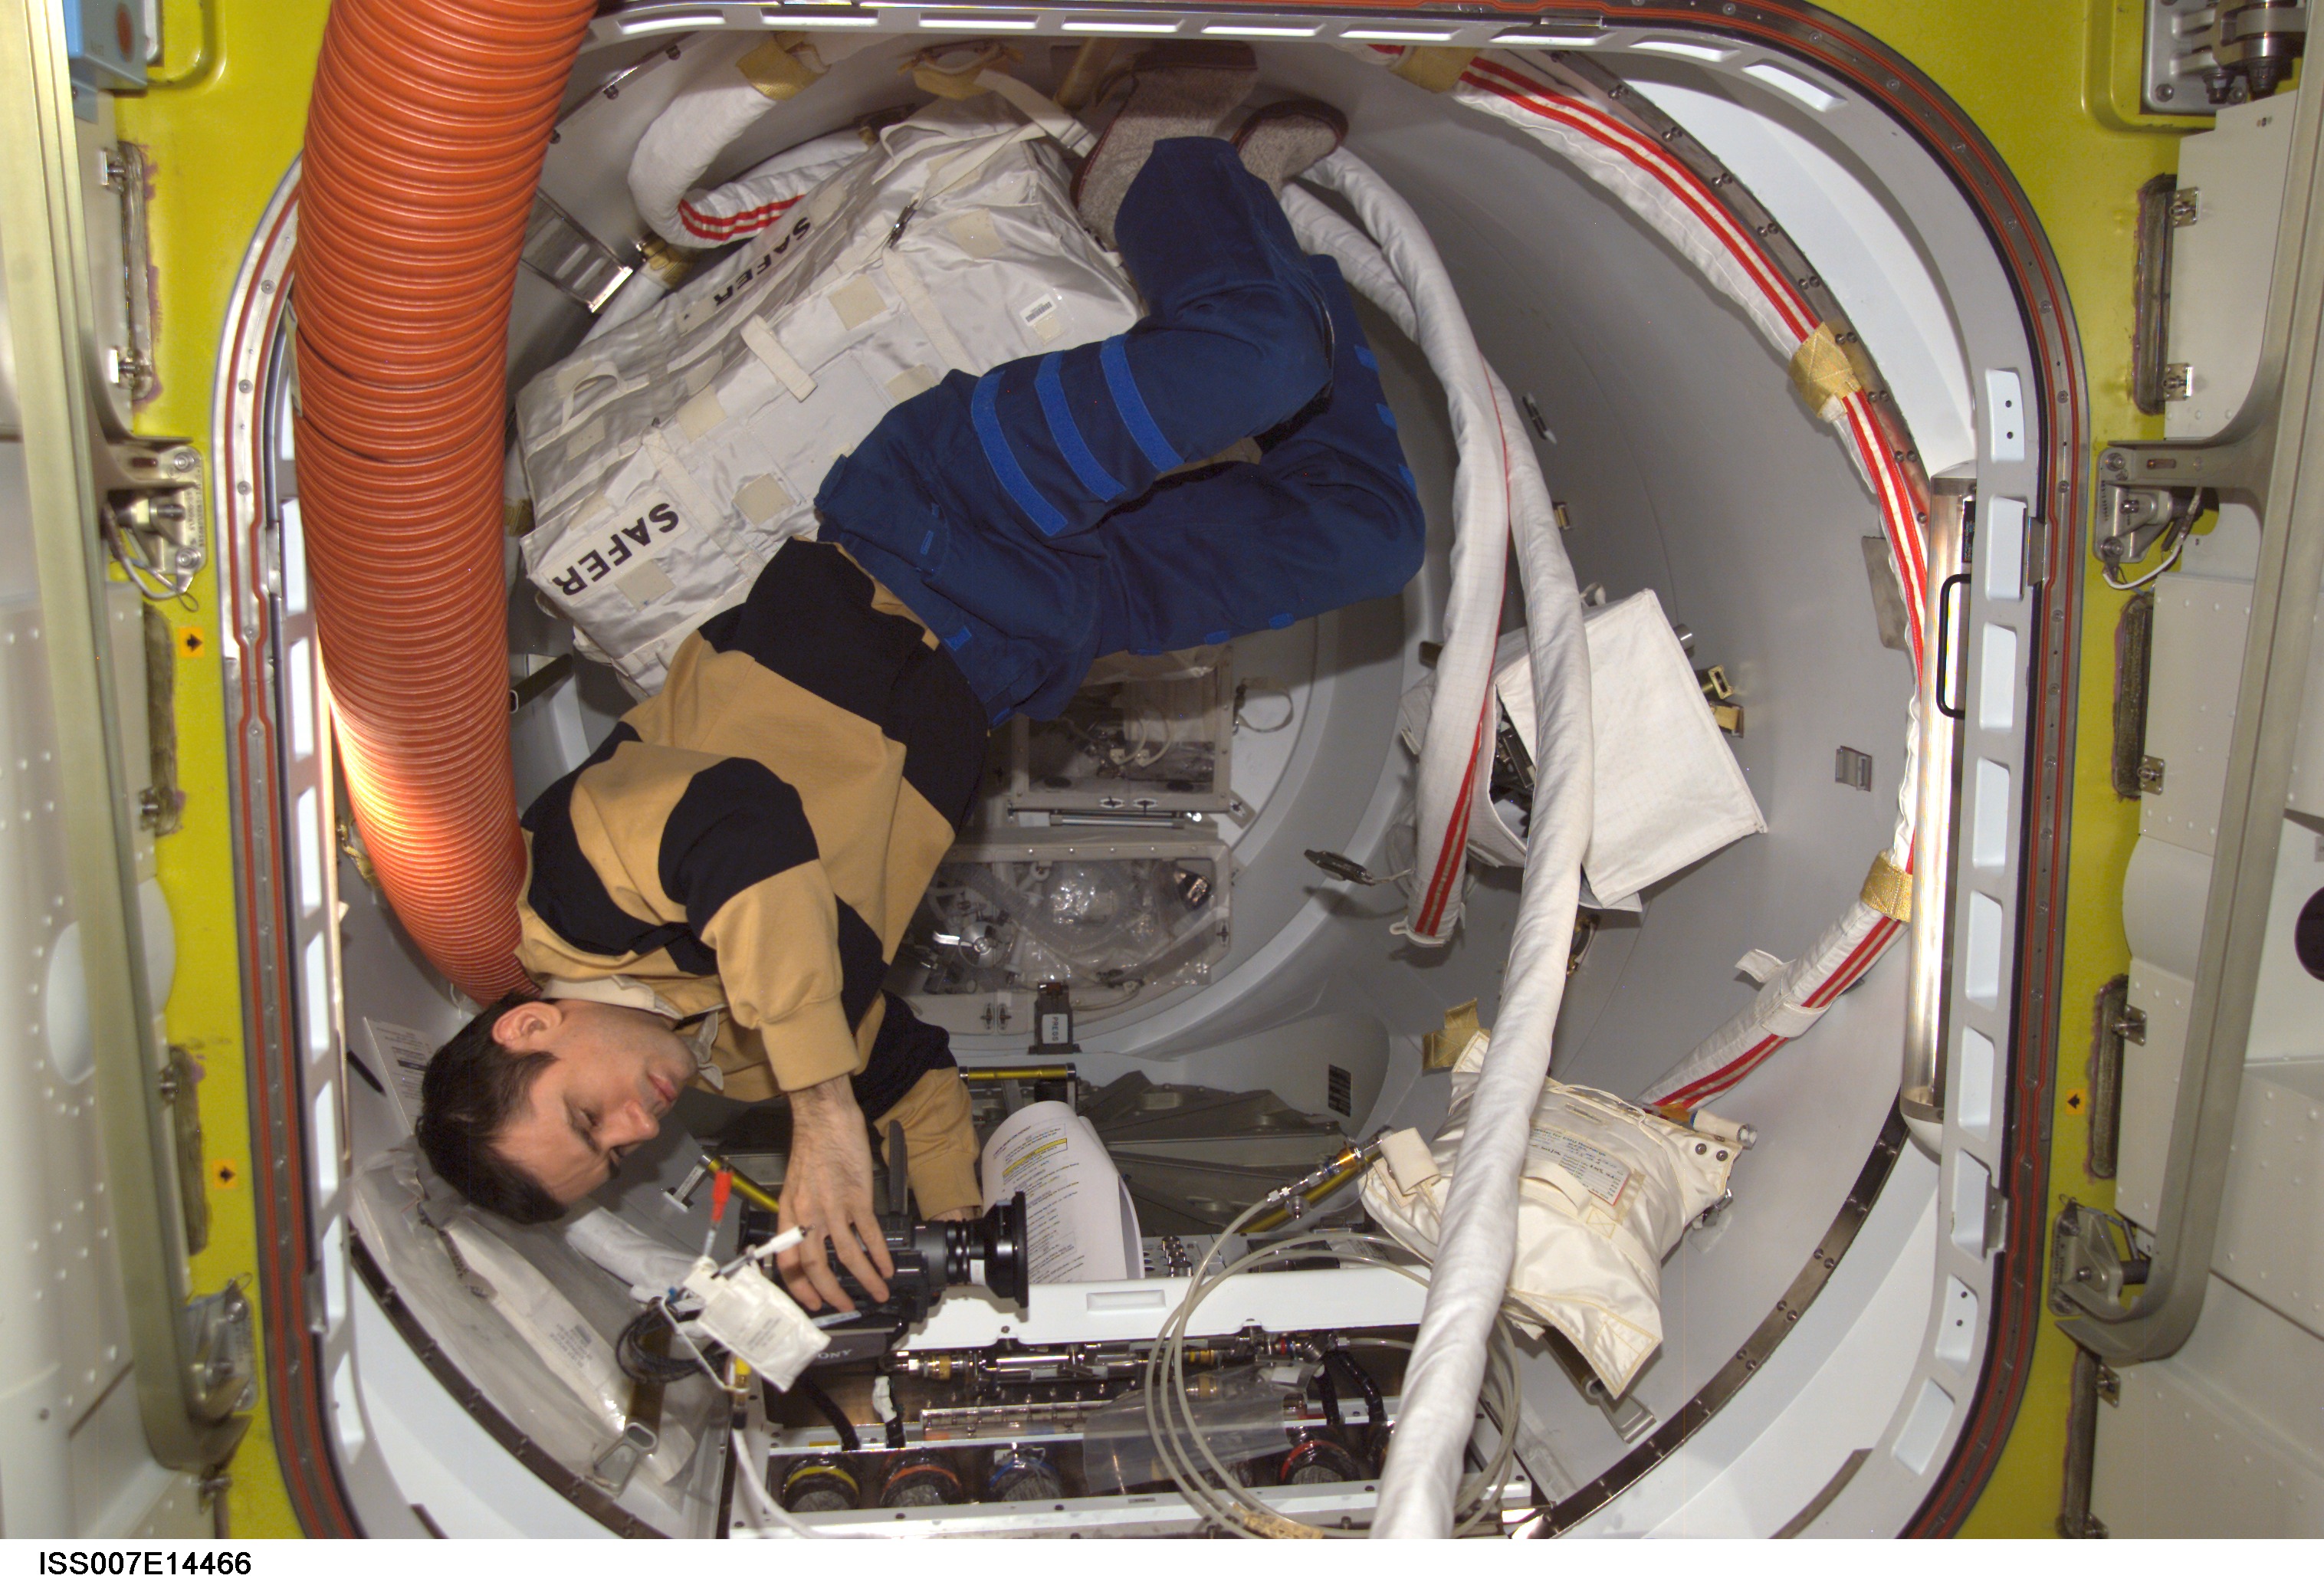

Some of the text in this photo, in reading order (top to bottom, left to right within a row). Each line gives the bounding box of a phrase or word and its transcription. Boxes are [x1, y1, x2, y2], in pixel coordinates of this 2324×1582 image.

[714, 217, 810, 307] SAFER
[552, 503, 679, 596] SAFER
[817, 1348, 852, 1360] ONY
